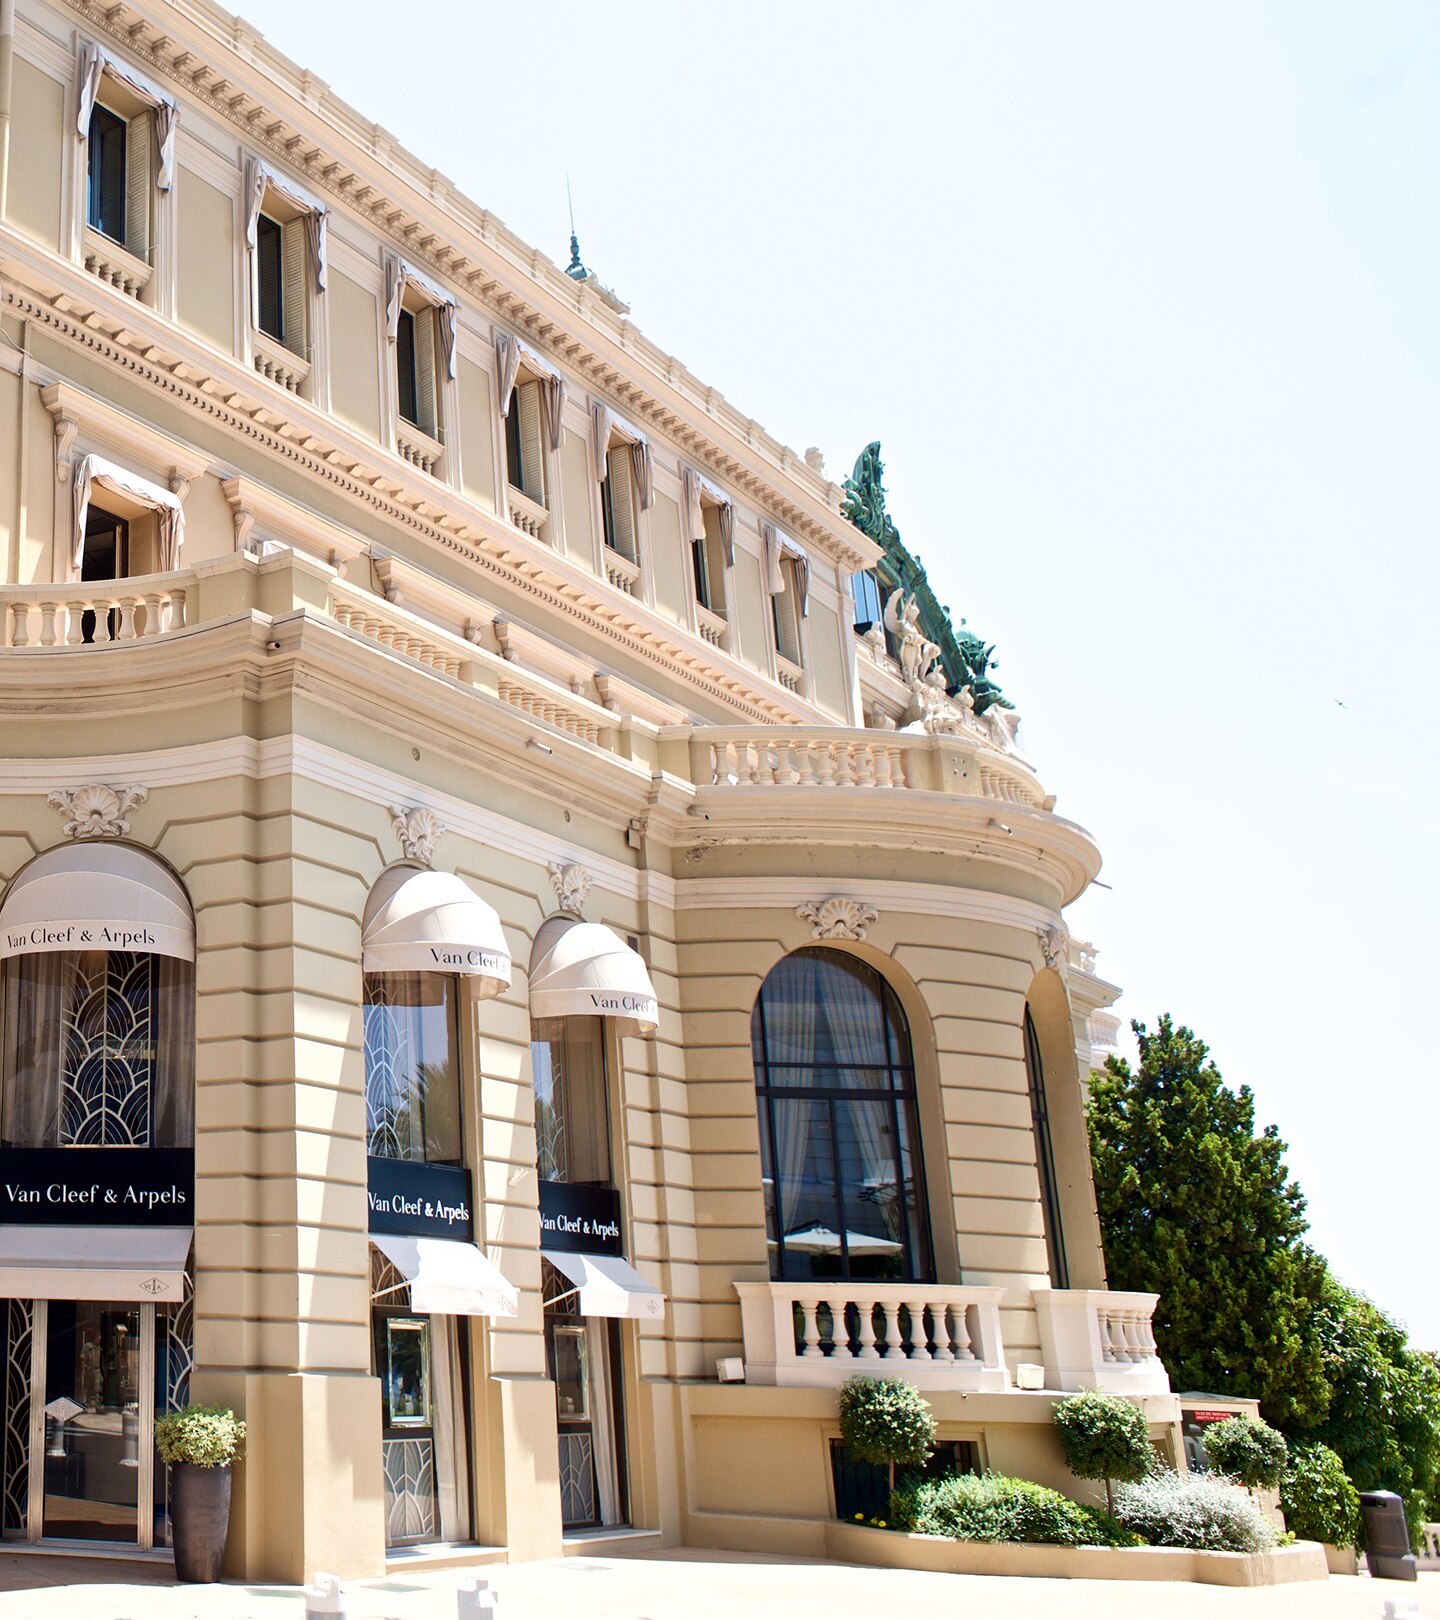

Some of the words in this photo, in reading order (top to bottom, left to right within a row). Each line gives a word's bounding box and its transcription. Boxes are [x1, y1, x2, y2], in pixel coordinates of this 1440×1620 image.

[7, 931, 26, 949] Van
[30, 926, 74, 945] Cleef
[80, 930, 92, 942] &
[98, 927, 155, 948] Arpels
[430, 948, 462, 964] Van
[591, 994, 618, 1009] Van
[5, 1184, 40, 1203] Van
[46, 1183, 99, 1203] Cleef
[104, 1189, 118, 1203] &
[123, 1185, 186, 1210] Arpels
[368, 1192, 390, 1212] Van
[392, 1194, 423, 1215] Cleef
[424, 1202, 433, 1217] &
[435, 1200, 469, 1225] Arpels
[557, 1214, 582, 1233] Cleef
[583, 1221, 590, 1234] &
[591, 1219, 619, 1241] Arpels
